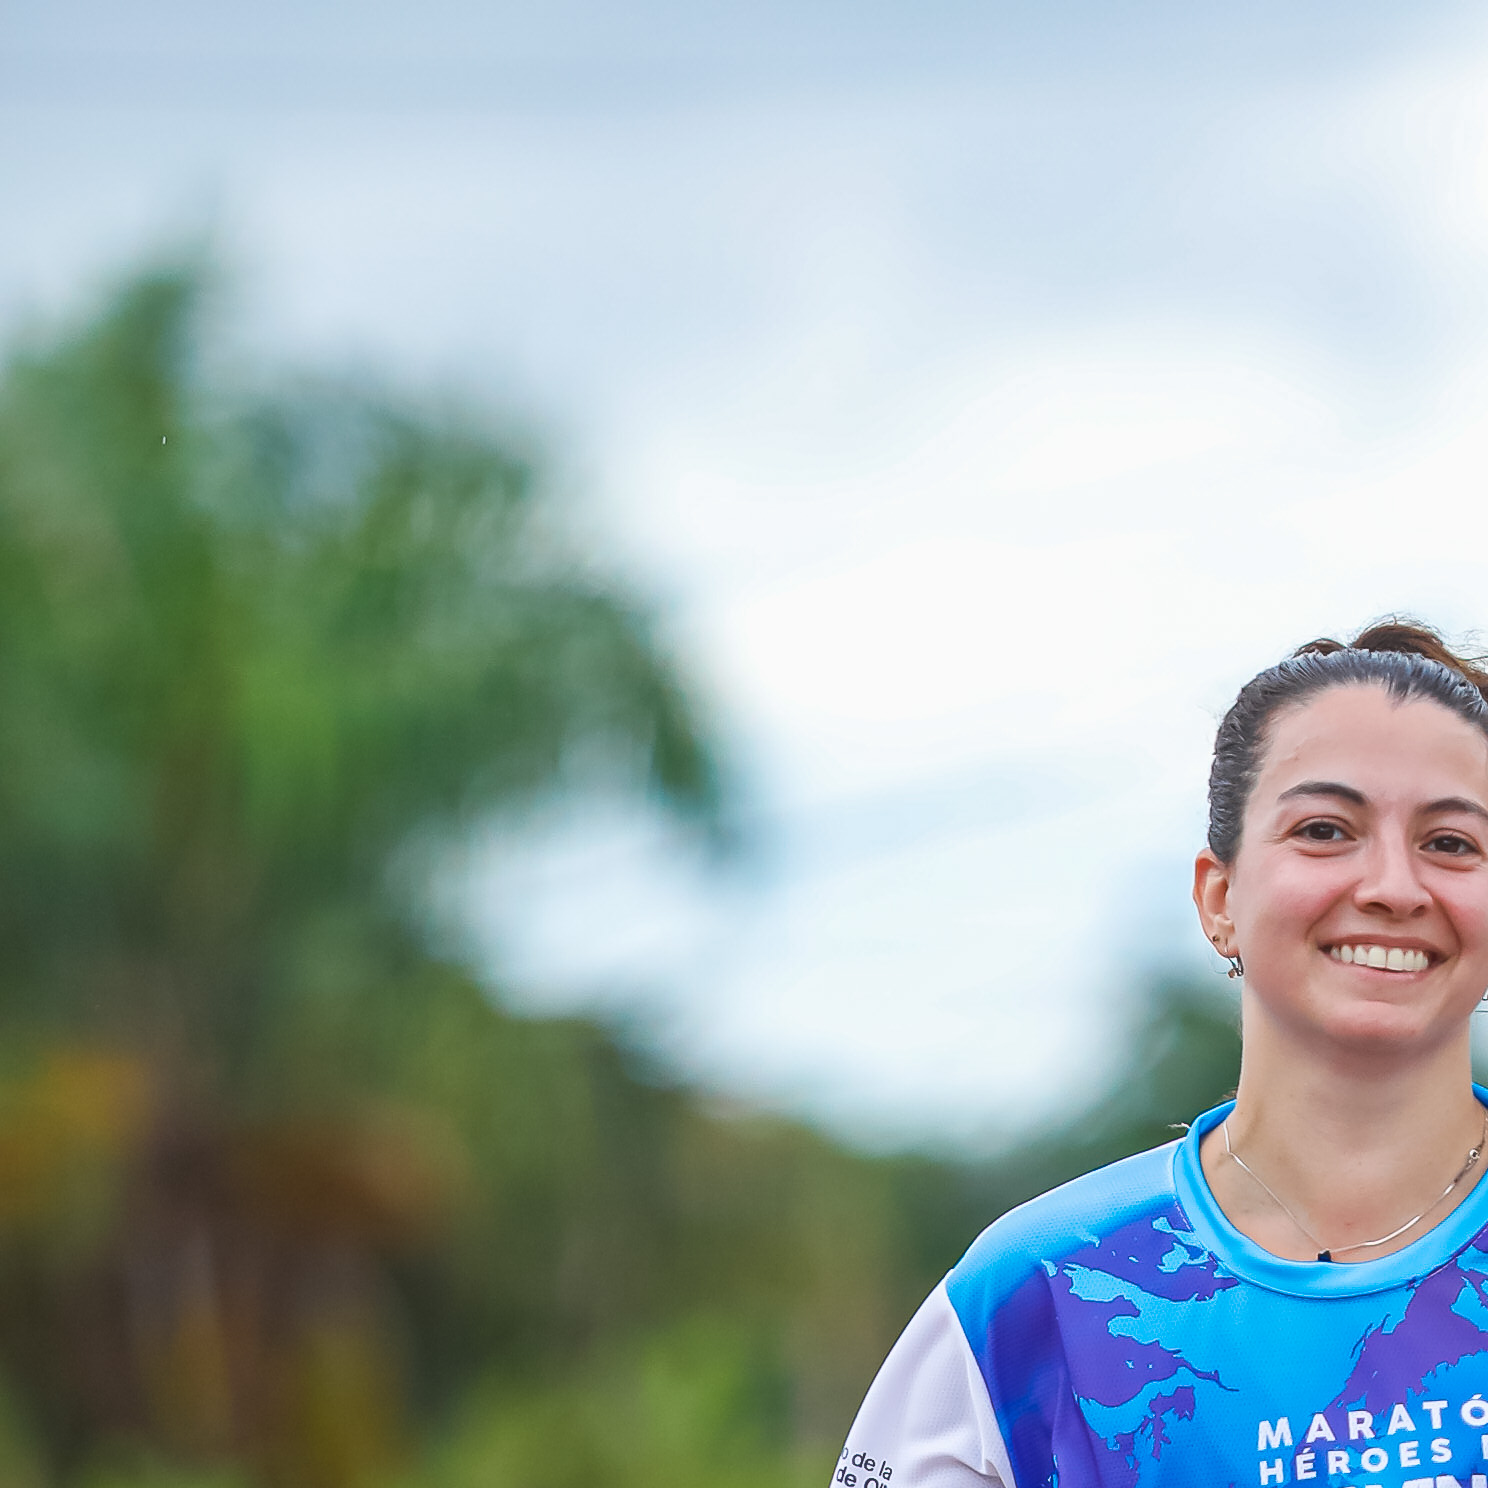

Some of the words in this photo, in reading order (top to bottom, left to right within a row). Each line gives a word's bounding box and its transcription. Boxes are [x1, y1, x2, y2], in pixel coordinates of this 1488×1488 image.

[851, 1452, 876, 1472] de
[878, 1460, 893, 1481] la
[1259, 1437, 1453, 1486] HÉROES
[836, 1466, 857, 1488] de
